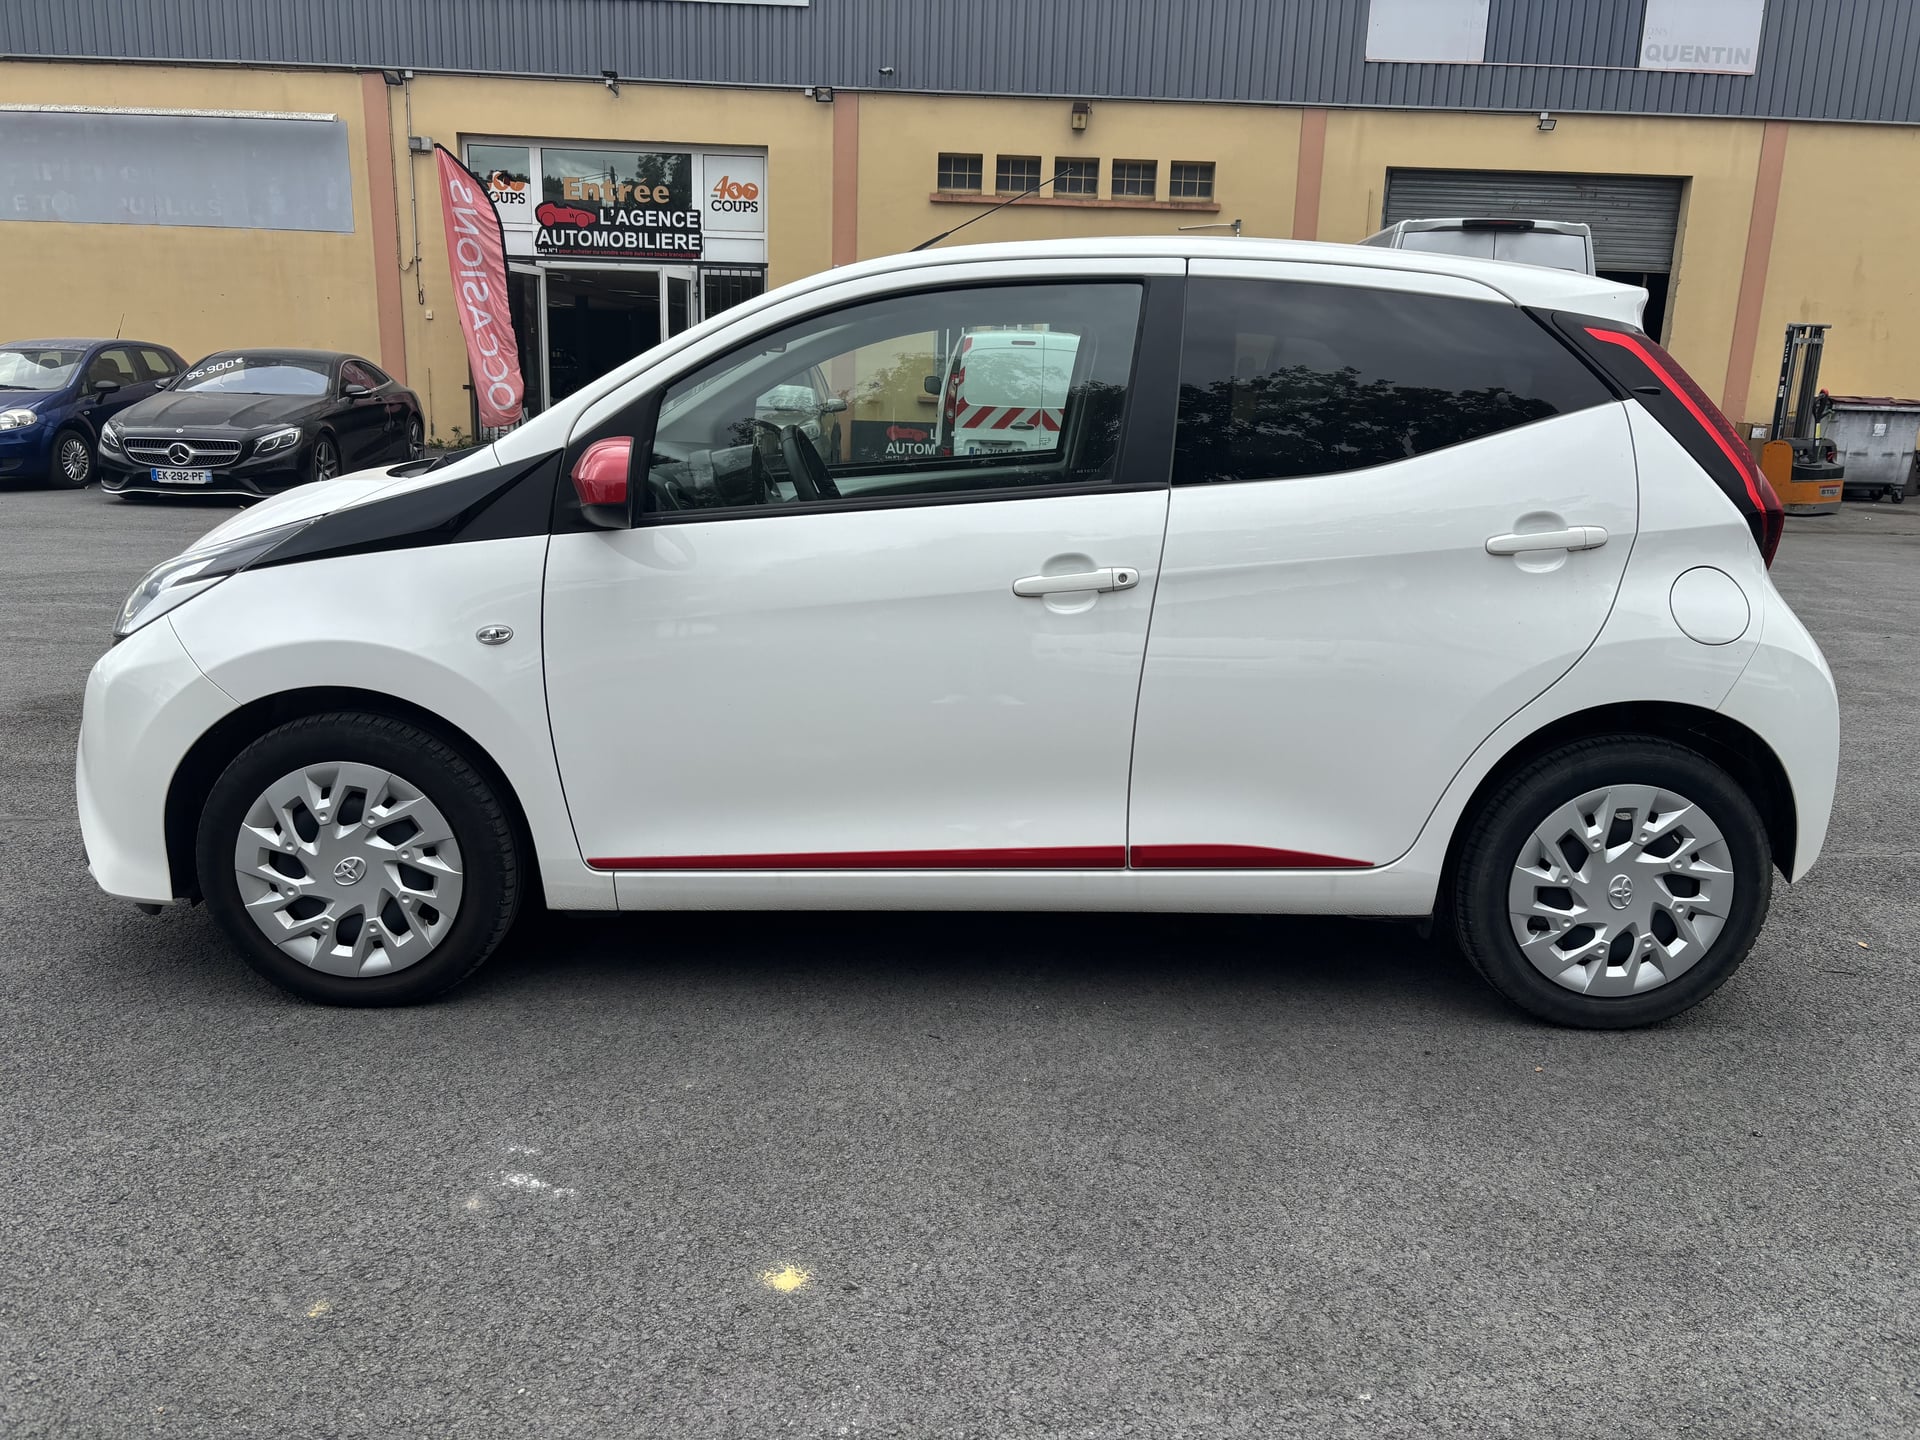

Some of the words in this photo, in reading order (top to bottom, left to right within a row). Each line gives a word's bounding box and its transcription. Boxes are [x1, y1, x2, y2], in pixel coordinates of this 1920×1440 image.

[1644, 44, 1751, 65] QUENTIN
[562, 177, 670, 203] Entrée
[713, 175, 759, 200] 400
[489, 191, 526, 204] OUPS
[711, 200, 758, 213] COUPS
[537, 228, 701, 250] AUTOMOBILIERE
[885, 442, 936, 455] AUTOM
[157, 470, 205, 481] EK-292-PF
